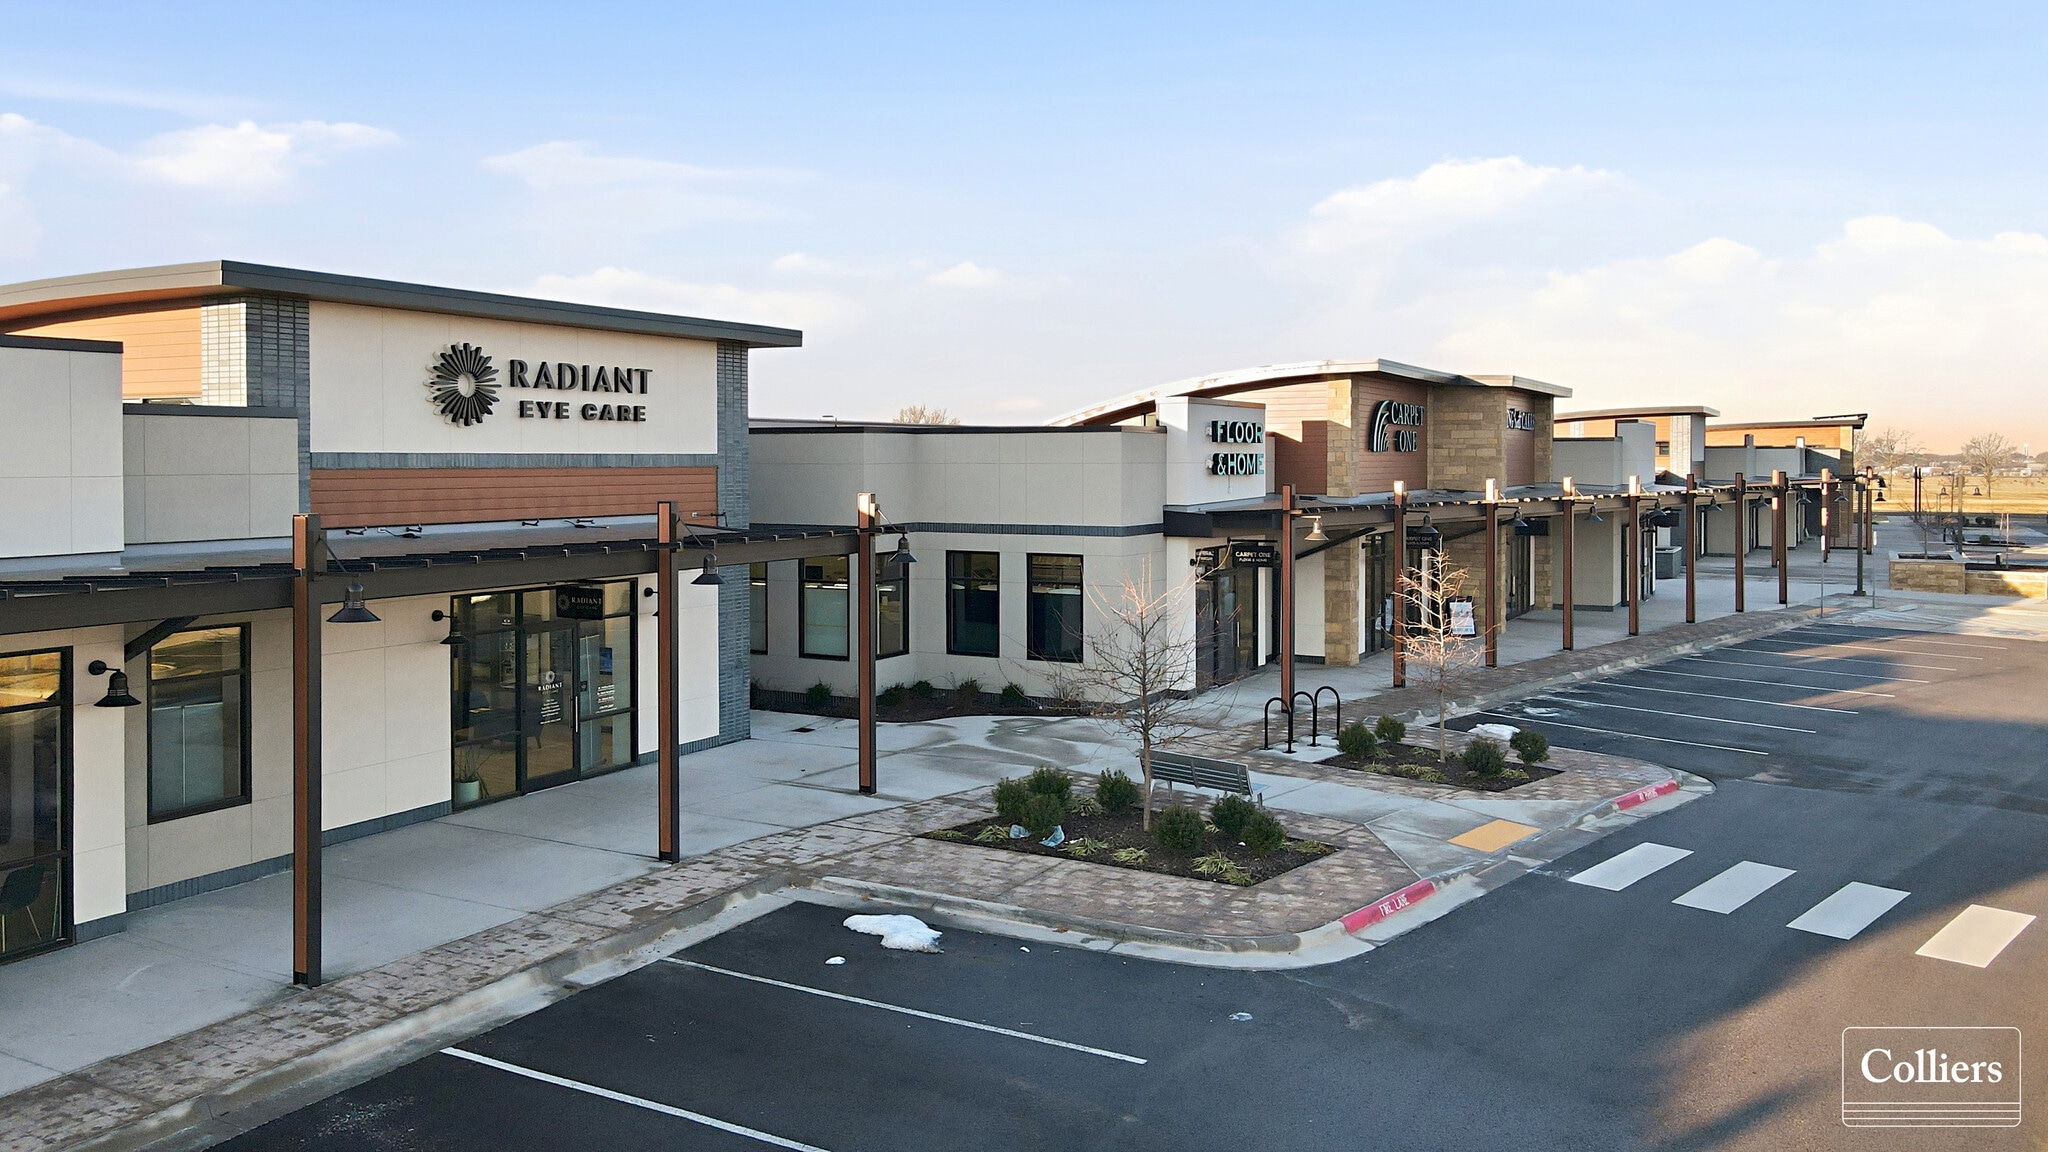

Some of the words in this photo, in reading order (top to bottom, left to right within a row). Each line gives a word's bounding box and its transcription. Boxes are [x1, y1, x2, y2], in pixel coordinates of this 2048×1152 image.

[509, 359, 653, 394] RADIANT
[519, 400, 570, 419] EYE
[582, 403, 647, 422] CARE
[1391, 401, 1425, 426] CARPET
[1215, 420, 1264, 444] FLOOR
[1398, 429, 1418, 452] ONE
[571, 596, 602, 605] RADIANT
[537, 682, 563, 692] RADIANT
